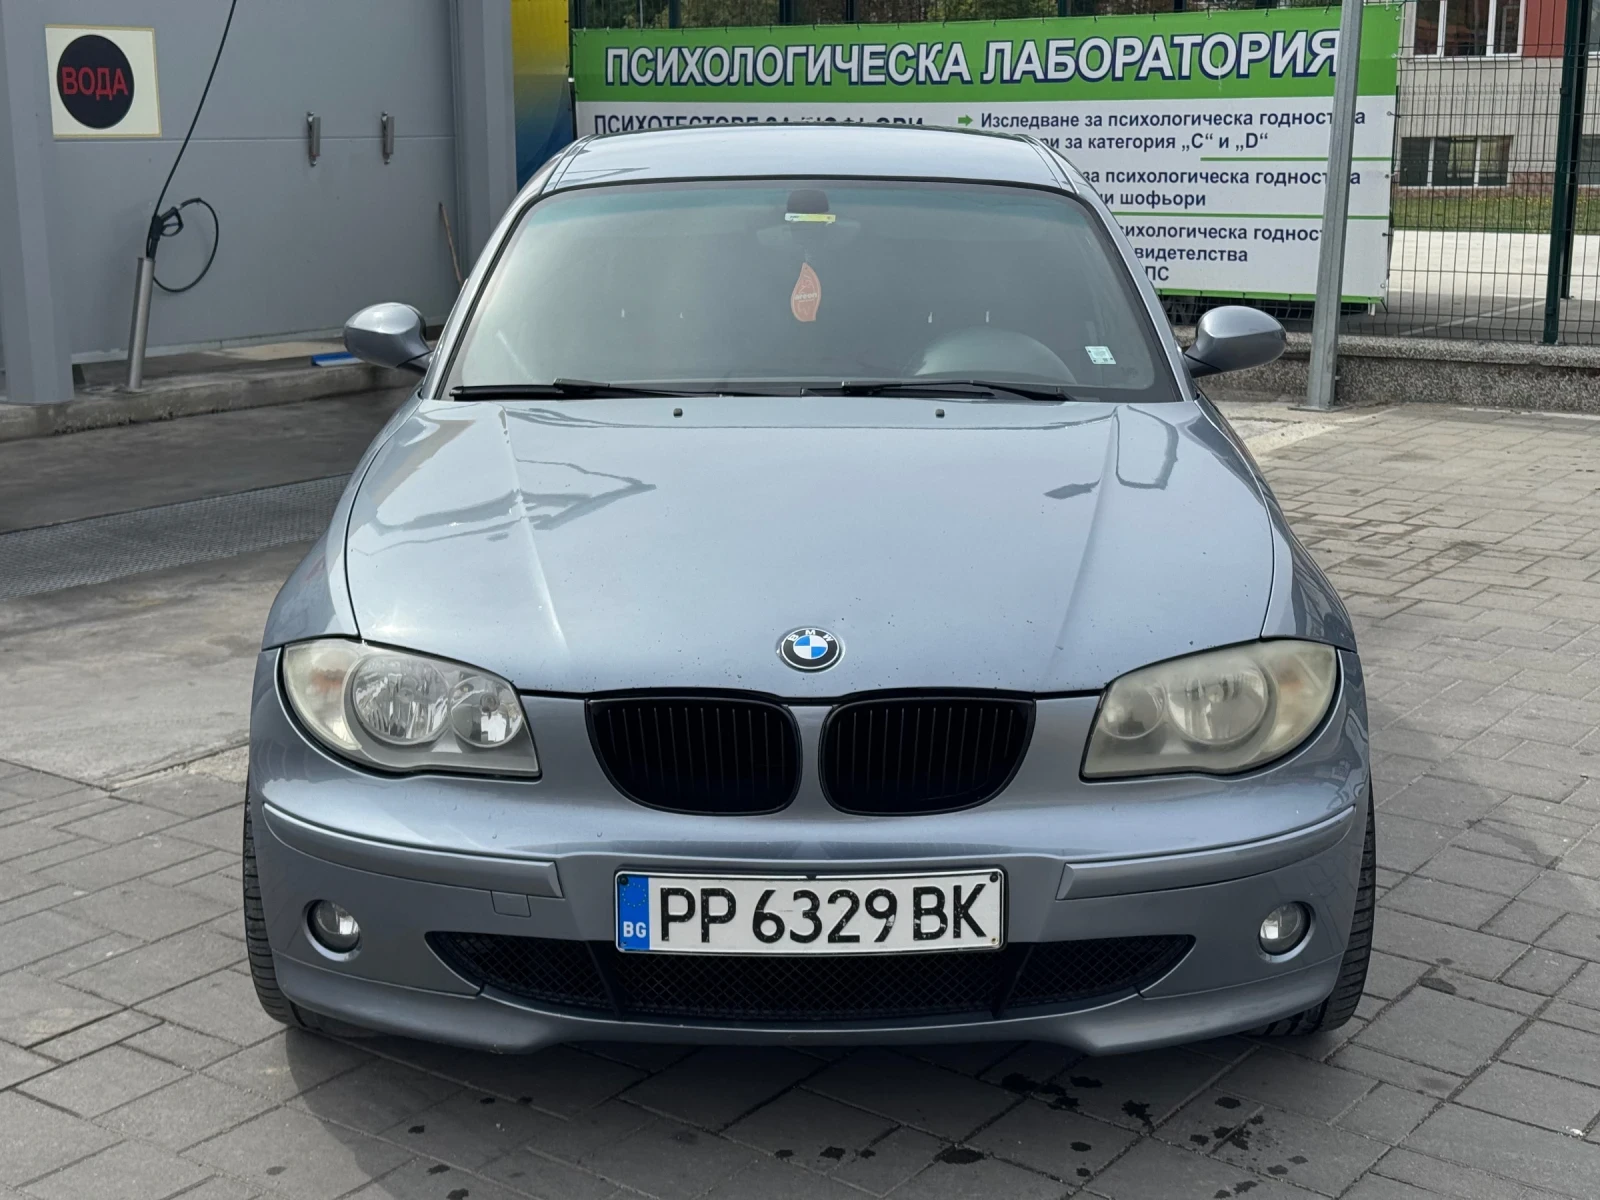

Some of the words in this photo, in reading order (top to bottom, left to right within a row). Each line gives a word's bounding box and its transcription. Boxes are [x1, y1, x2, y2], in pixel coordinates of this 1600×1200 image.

[606, 42, 973, 85] ПСИХОЛОГИЧЕСКА
[980, 28, 1340, 84] ЛАБОРАТОРИЯ
[61, 66, 129, 101] ВОДА
[981, 112, 1079, 130] Изследване
[1085, 115, 1102, 128] за
[1108, 112, 1253, 127] психологическа
[1260, 111, 1365, 128] годноста
[1065, 137, 1082, 149] за
[1088, 136, 1176, 152] категория
[1219, 136, 1229, 149] и
[1082, 171, 1100, 183] за
[1106, 171, 1249, 184] психологическа
[1120, 190, 1206, 209] шофьори
[1254, 228, 1322, 243] годнос
[1134, 247, 1248, 262] видетелства
[787, 629, 834, 642] BMW
[659, 887, 737, 944] PP
[752, 888, 899, 944] 6329
[912, 883, 988, 941] BK
[623, 921, 647, 938] BG
